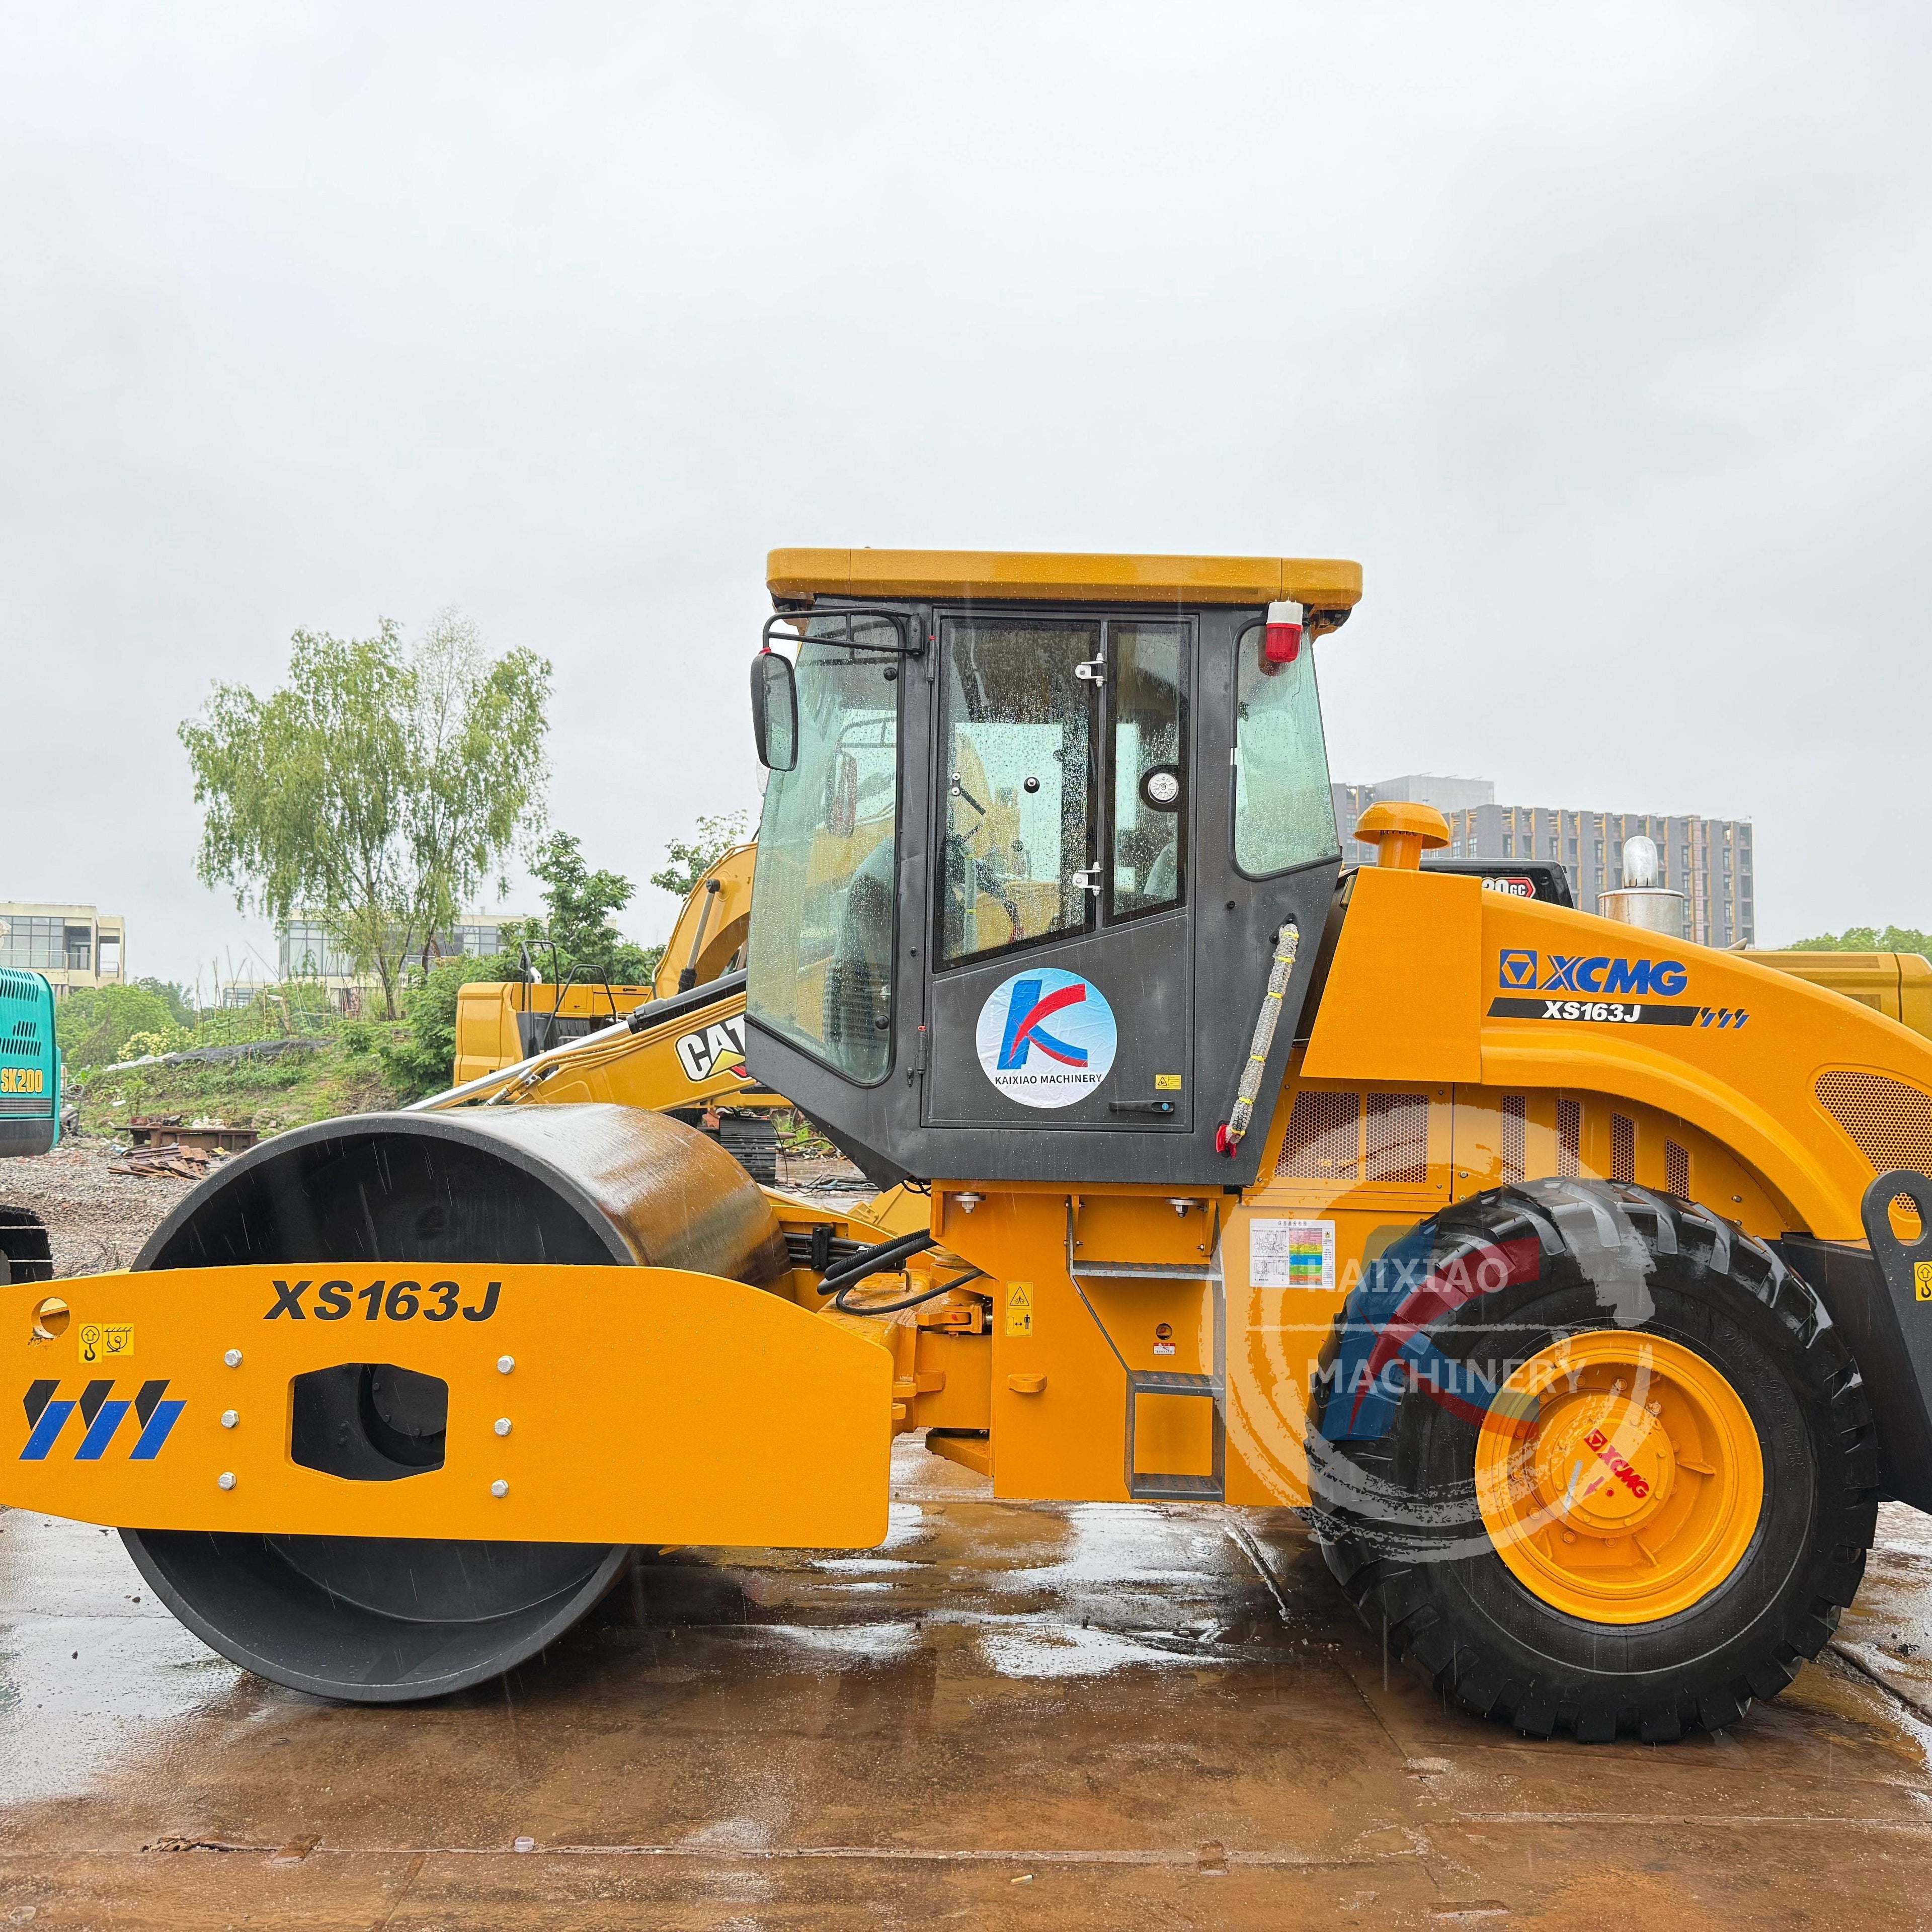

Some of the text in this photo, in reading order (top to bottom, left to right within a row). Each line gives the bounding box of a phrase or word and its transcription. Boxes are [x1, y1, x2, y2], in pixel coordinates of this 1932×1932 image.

[1539, 955, 1688, 996] XCMG
[1542, 1001, 1641, 1022] XS163J
[1, 1068, 43, 1093] SK200
[995, 1074, 1102, 1085] KAIXIAO MACHINERY
[263, 1280, 502, 1322] XS163J
[1597, 1444, 1649, 1498] XCMG
